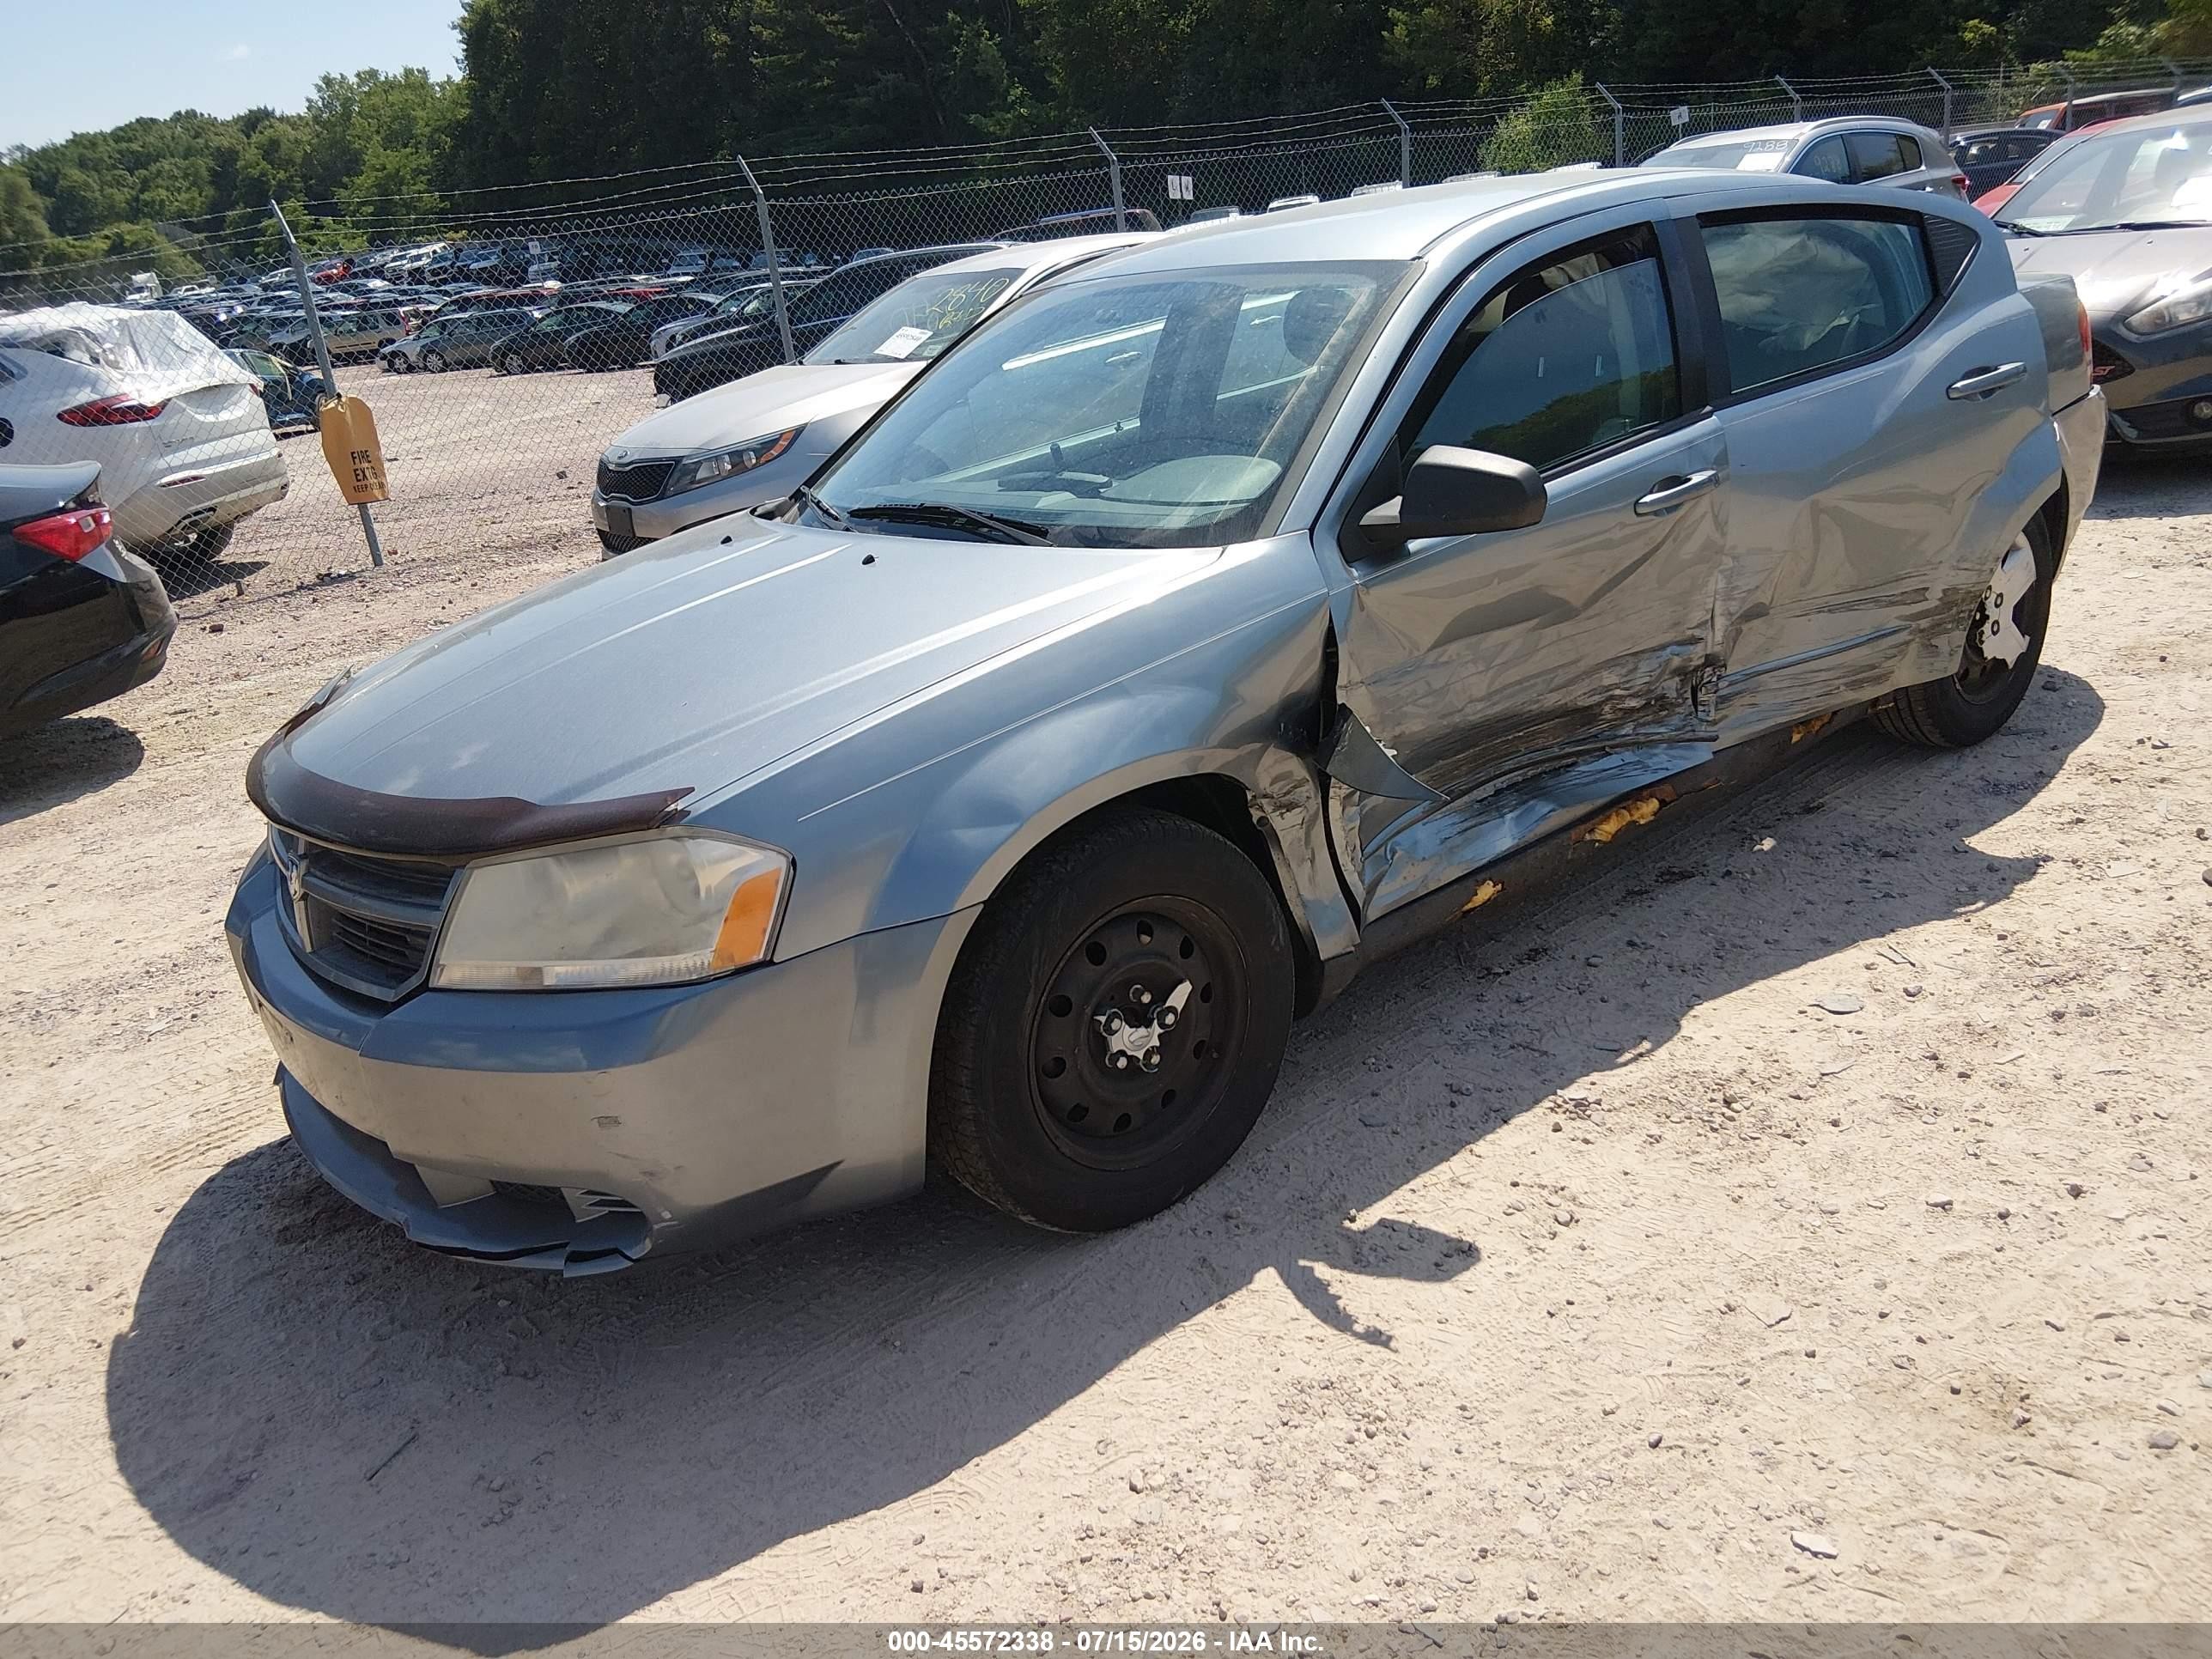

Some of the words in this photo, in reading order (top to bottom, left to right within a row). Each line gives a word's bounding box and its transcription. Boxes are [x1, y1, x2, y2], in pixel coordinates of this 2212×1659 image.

[927, 276, 1010, 313] 2840
[2092, 365, 2116, 376] ST
[350, 450, 371, 465] FIRE
